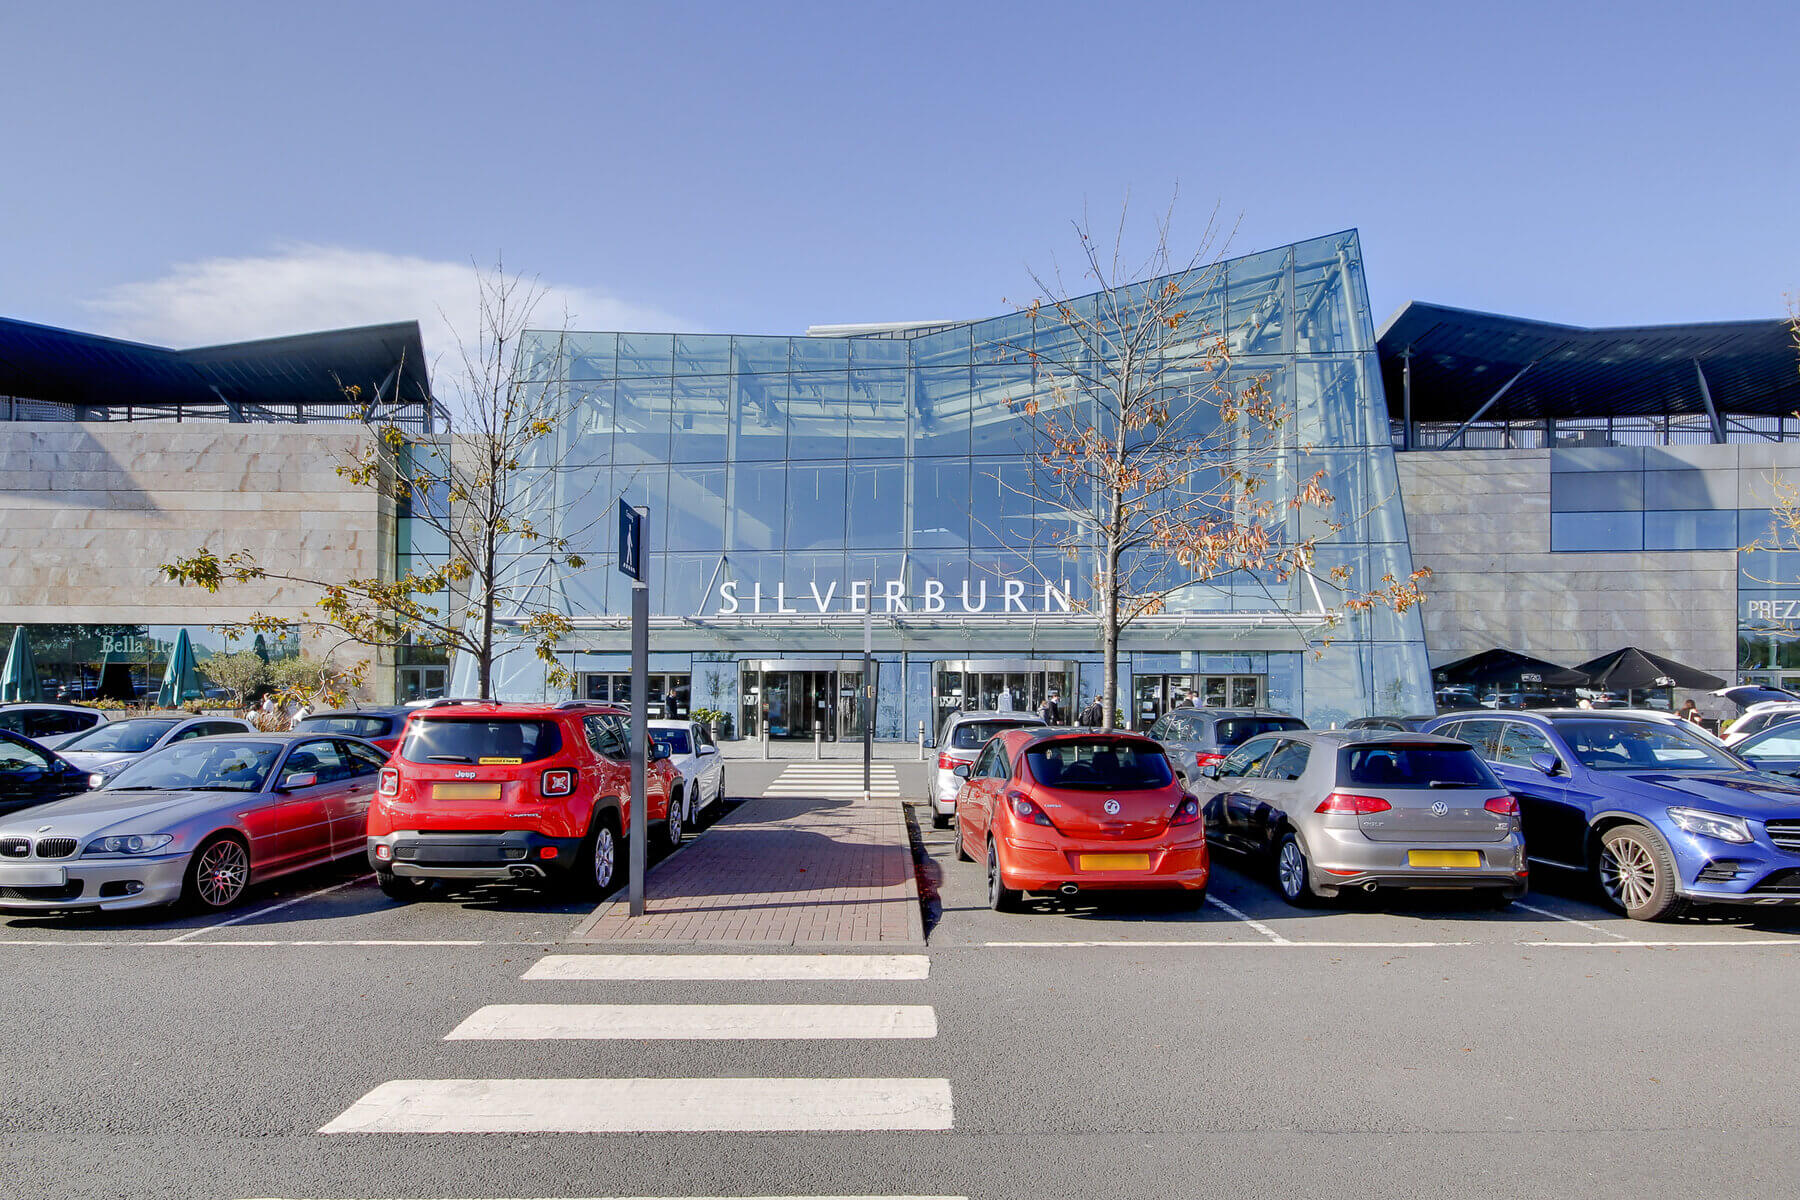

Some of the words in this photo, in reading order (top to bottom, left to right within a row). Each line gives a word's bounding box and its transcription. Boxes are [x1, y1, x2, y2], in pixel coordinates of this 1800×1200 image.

[718, 580, 1073, 614] SILVERBURN
[1748, 600, 1800, 619] PREZ
[99, 635, 145, 653] Bella
[152, 638, 199, 653] Itaa
[455, 770, 476, 780] Jeep
